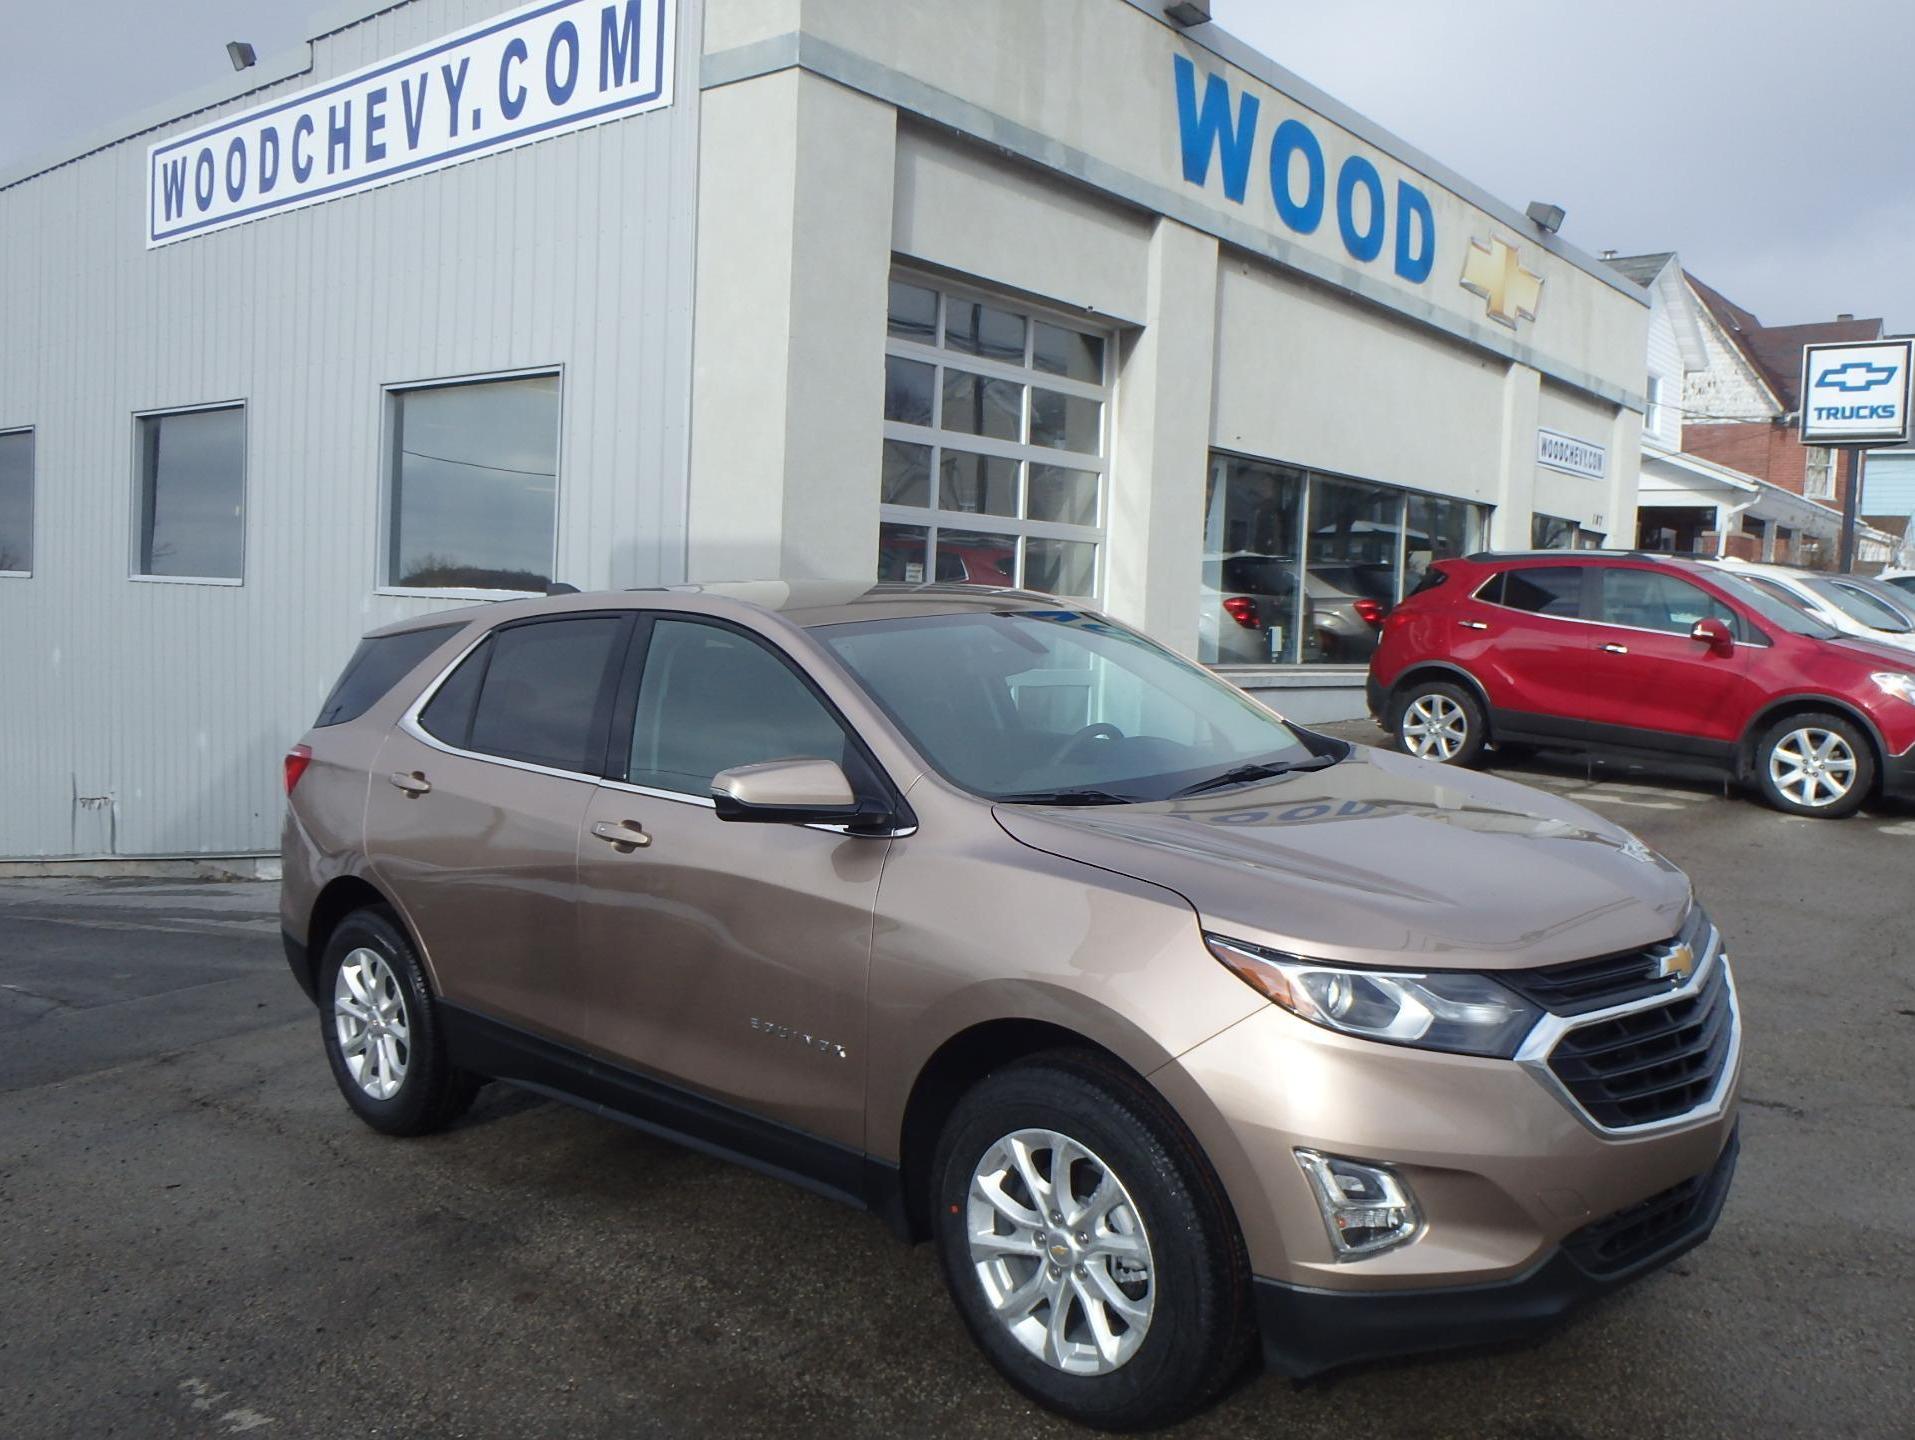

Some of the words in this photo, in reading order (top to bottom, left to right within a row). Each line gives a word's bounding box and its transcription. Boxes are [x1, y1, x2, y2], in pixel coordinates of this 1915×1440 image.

[163, 0, 642, 221] WOODCHEVY.COM
[1173, 52, 1435, 284] WOOD
[1814, 404, 1896, 420] TRUCKS
